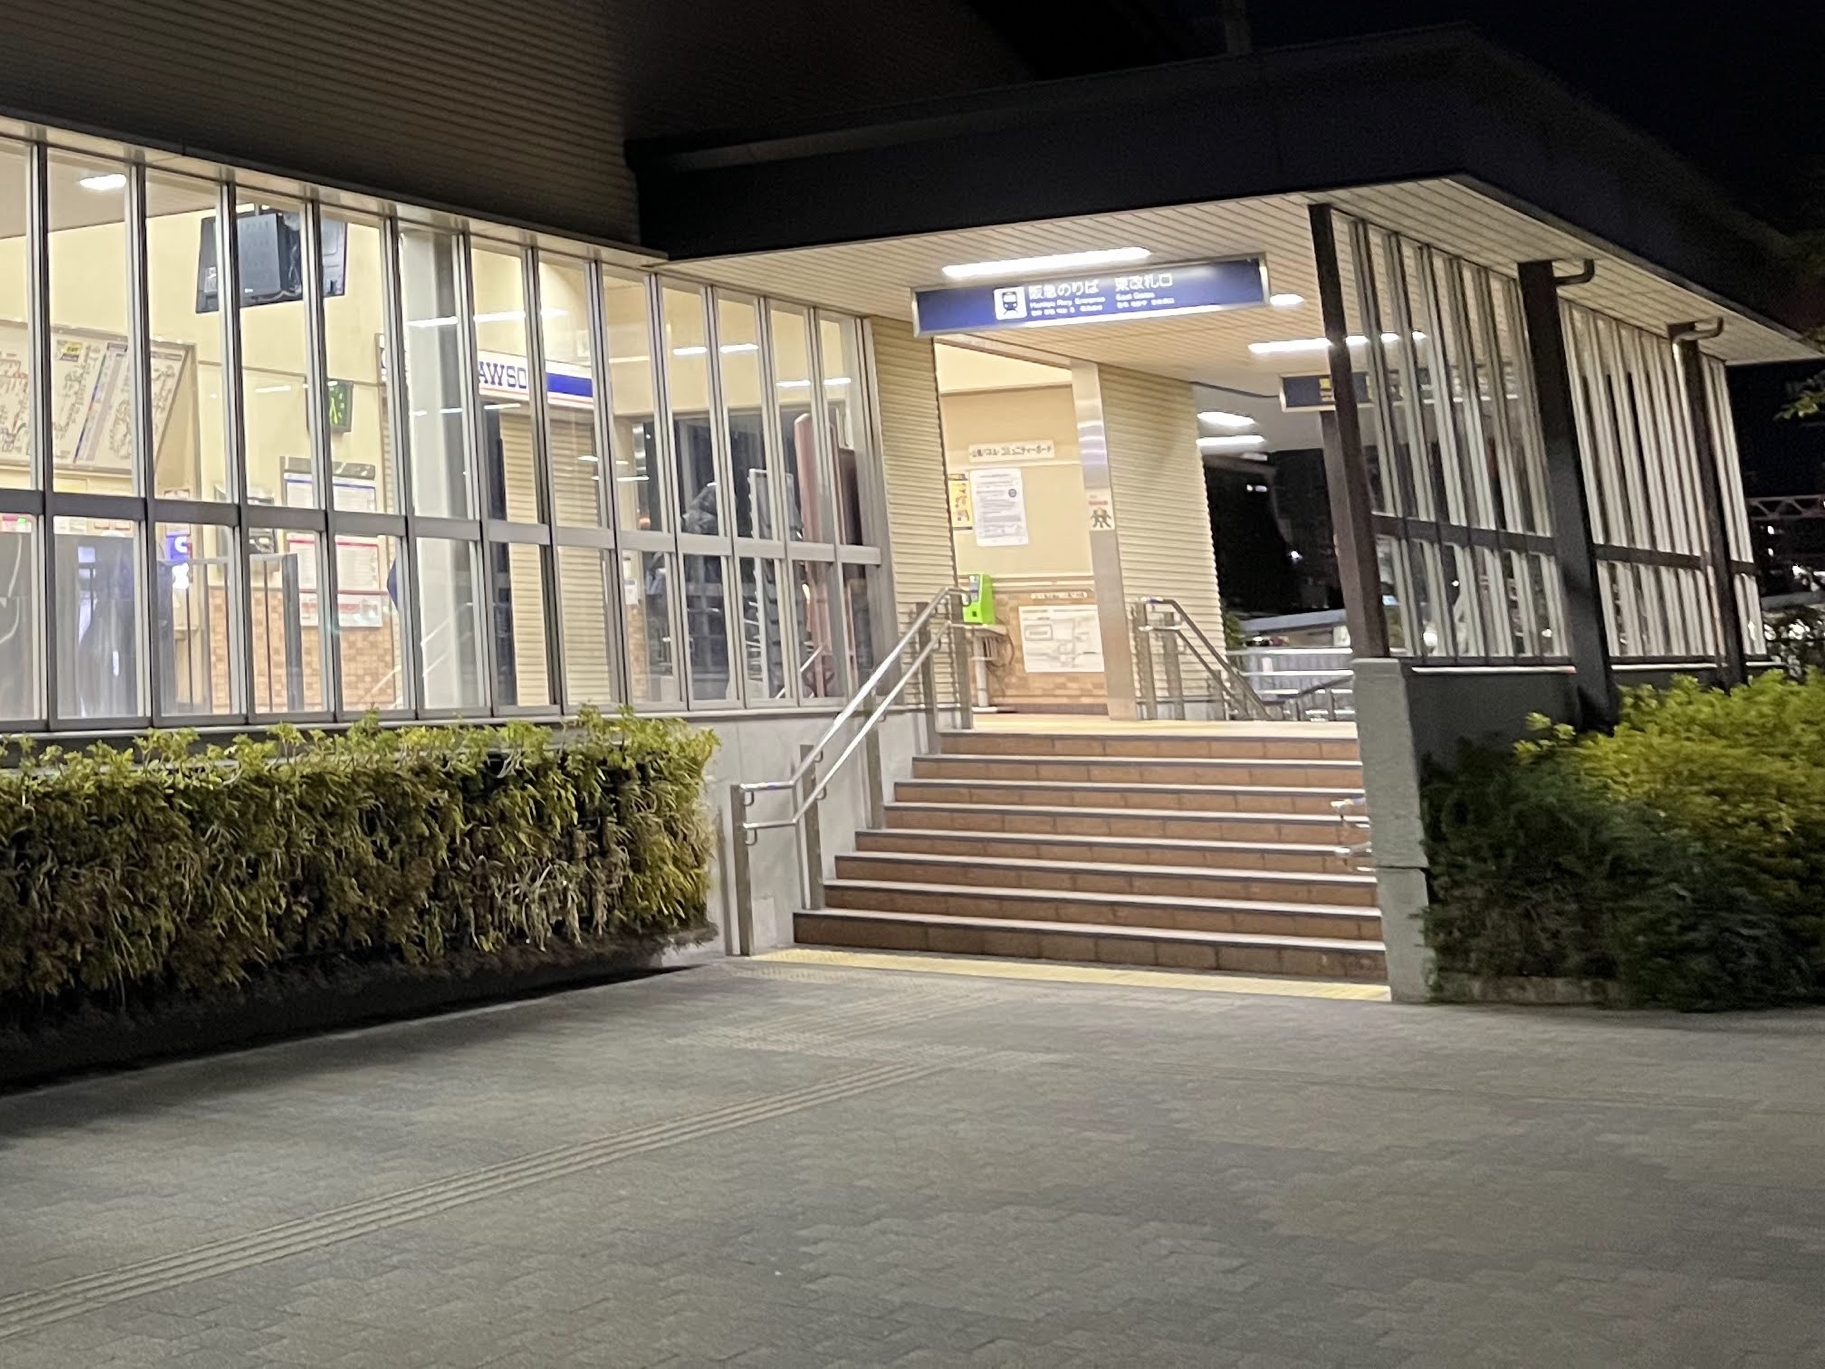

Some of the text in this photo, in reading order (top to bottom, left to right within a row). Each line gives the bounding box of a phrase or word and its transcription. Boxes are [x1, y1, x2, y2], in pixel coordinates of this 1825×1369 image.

[1028, 273, 1173, 300] 阪急のりば 東改札口
